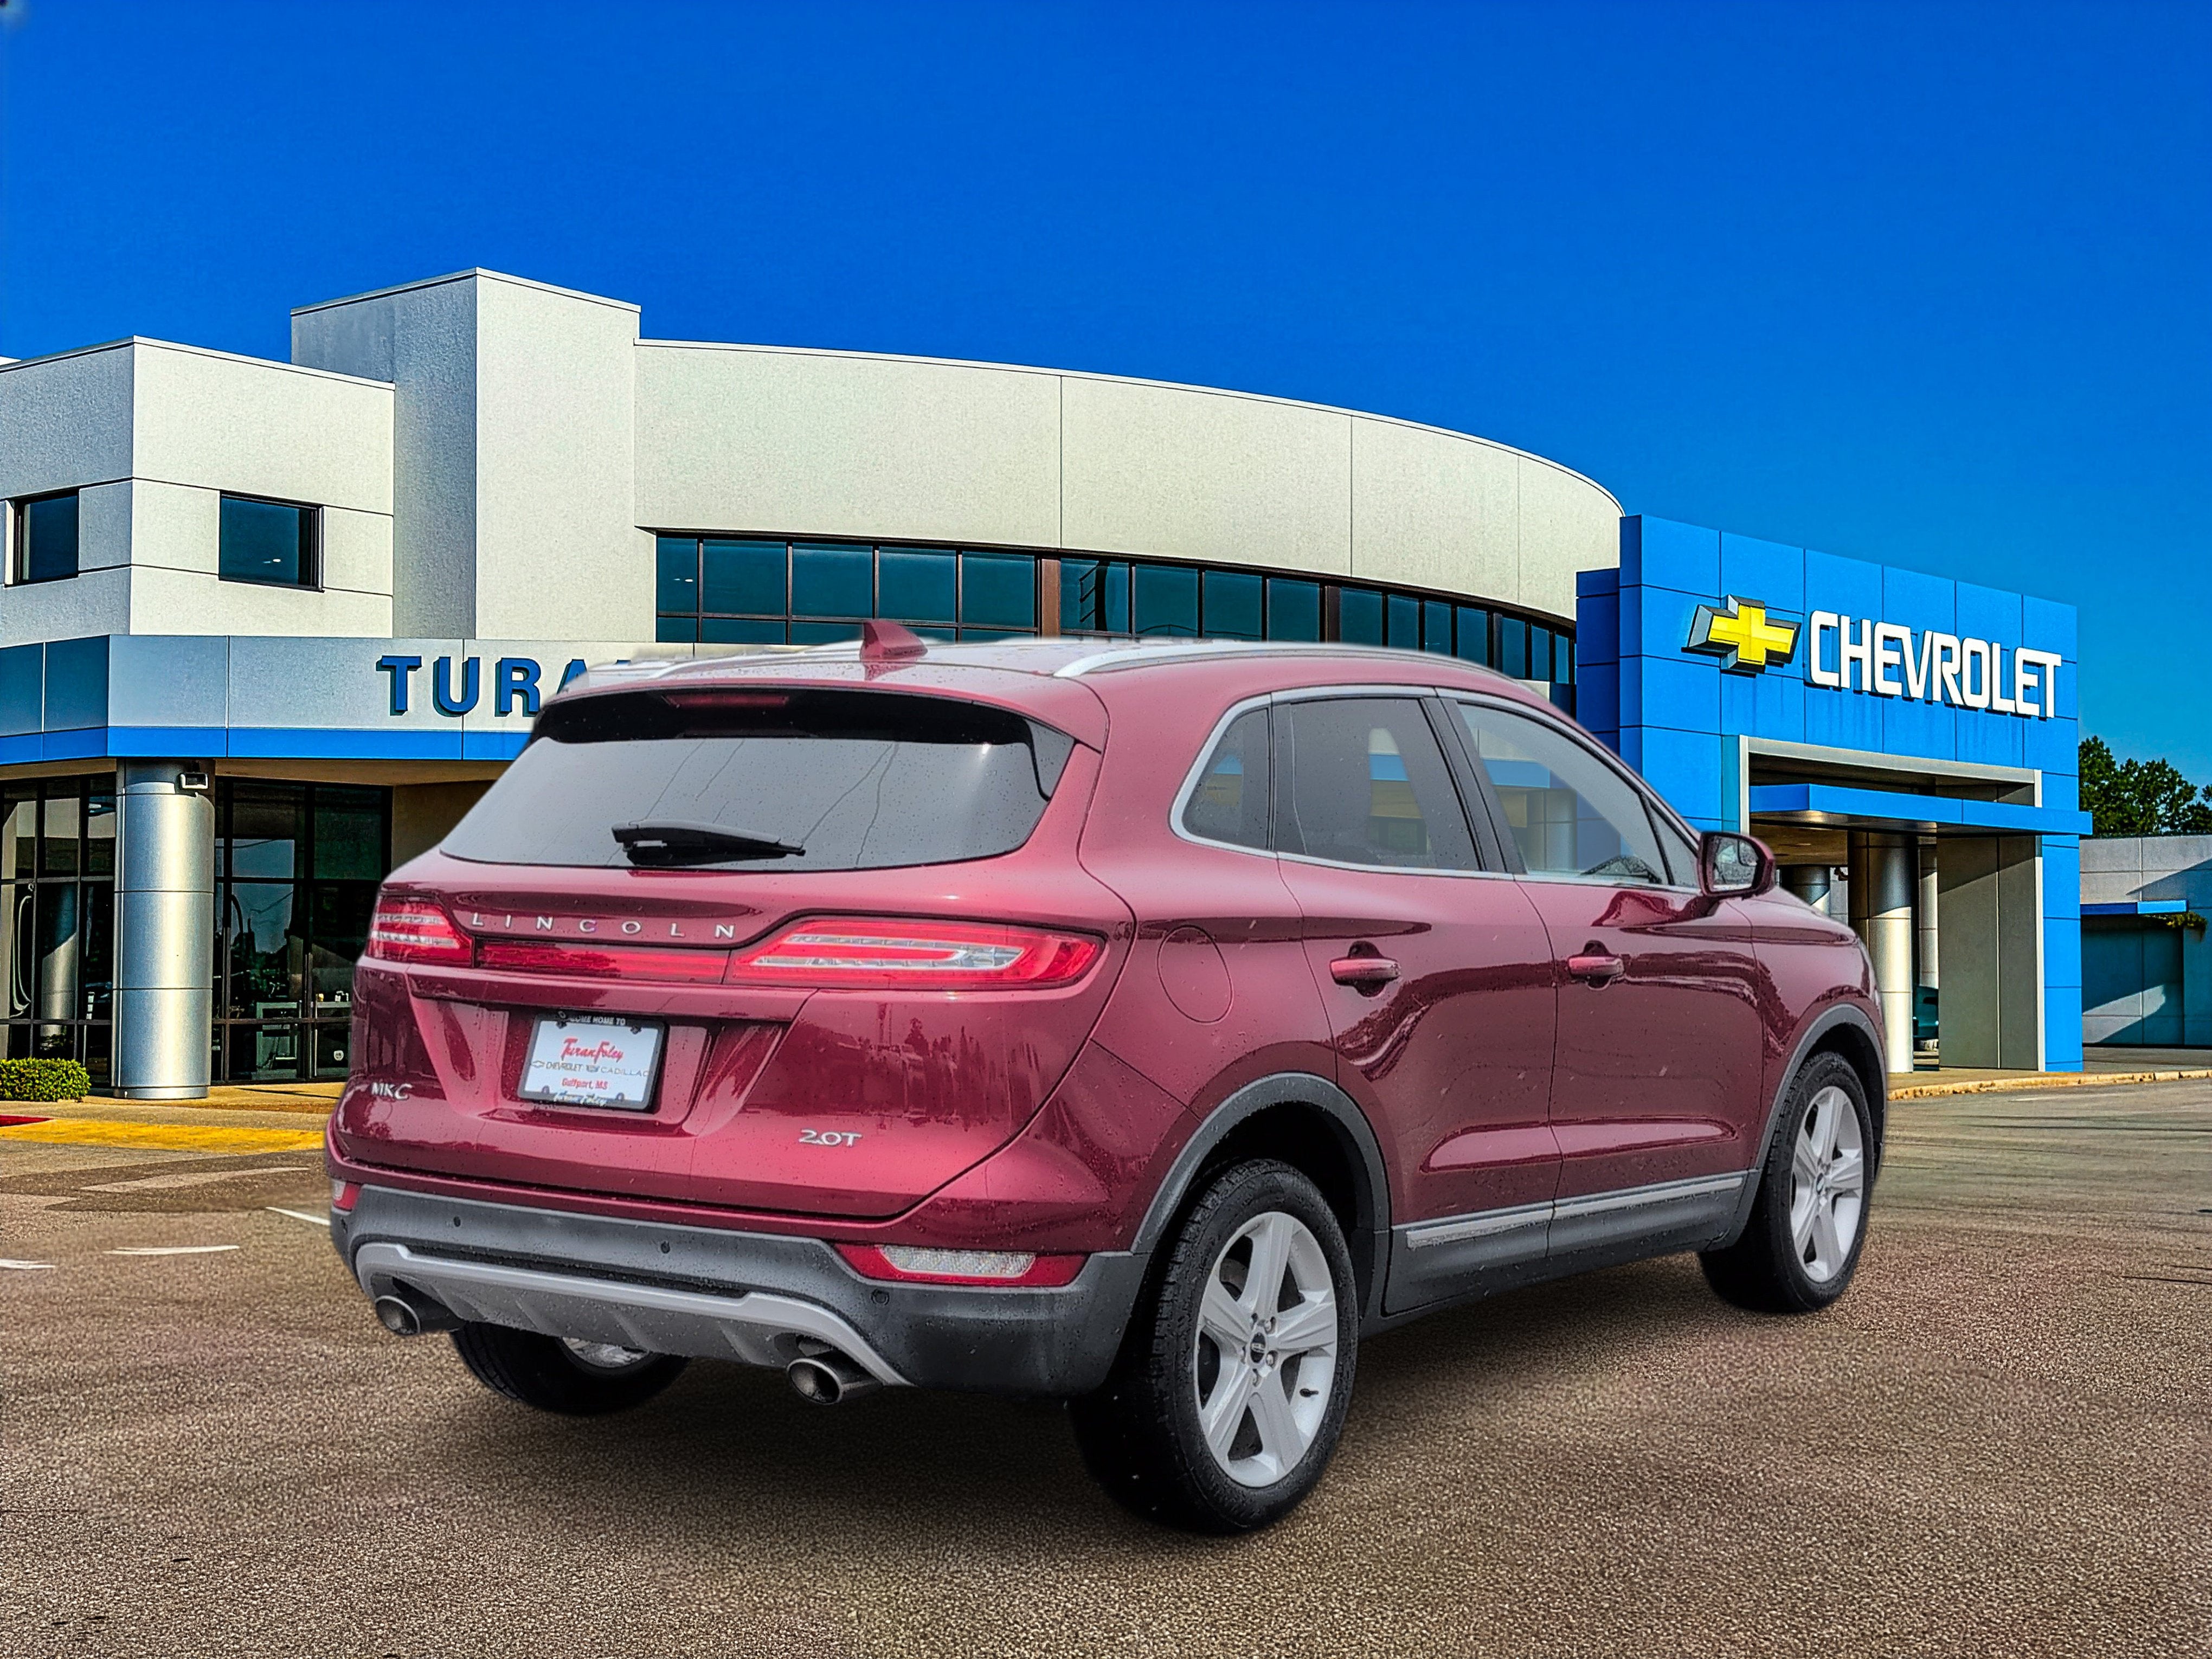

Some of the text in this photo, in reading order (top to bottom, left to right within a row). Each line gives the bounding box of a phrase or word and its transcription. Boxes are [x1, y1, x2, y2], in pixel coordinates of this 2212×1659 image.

[1810, 609, 2062, 718] CHEVROLET
[376, 655, 631, 717] TURA
[471, 912, 735, 938] LINCOLN
[600, 1065, 650, 1077] CADILLAC
[371, 1082, 413, 1100] MKC
